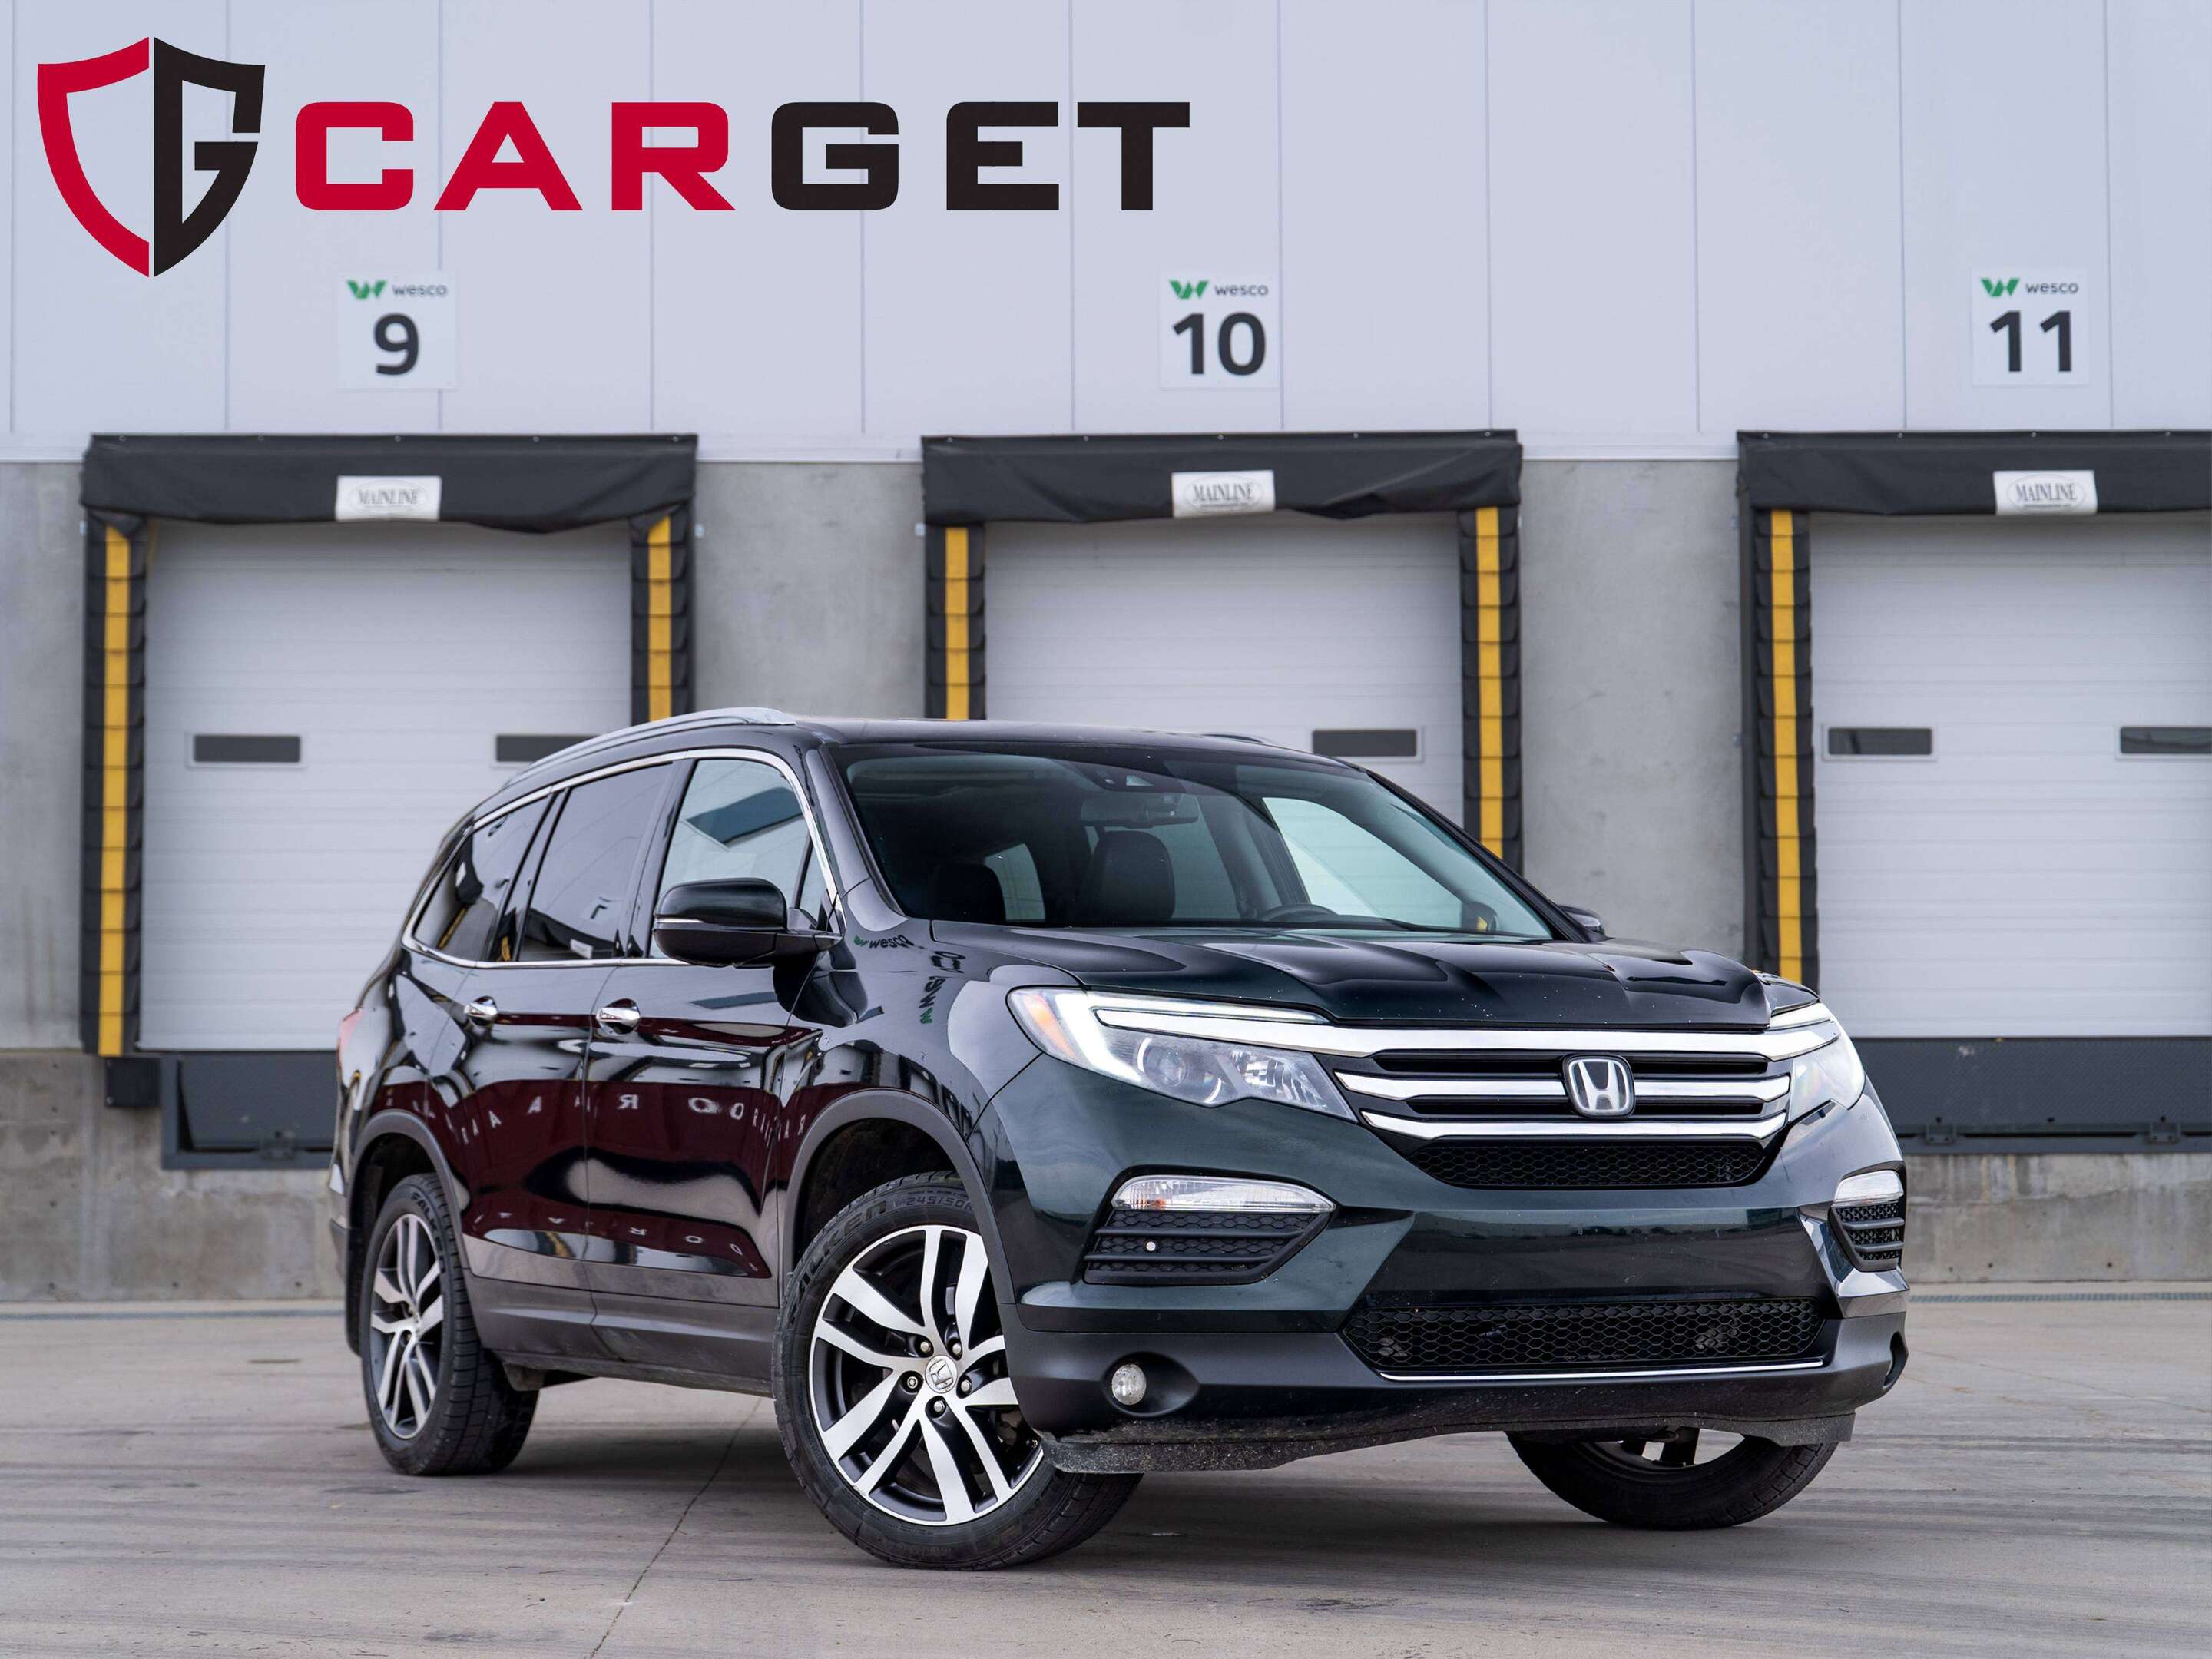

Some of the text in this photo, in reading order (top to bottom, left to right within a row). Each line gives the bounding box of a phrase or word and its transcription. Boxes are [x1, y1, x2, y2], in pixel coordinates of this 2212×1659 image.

[392, 284, 448, 296] wesco
[1214, 284, 1269, 296] wesco
[2025, 282, 2079, 295] wesco
[374, 313, 419, 376] 9
[1173, 312, 1266, 376] 10
[1990, 310, 2071, 372] 11
[358, 488, 419, 505] MAINLINE
[1194, 483, 1253, 501] MAINLINE
[2015, 482, 2078, 501] MAINLINE
